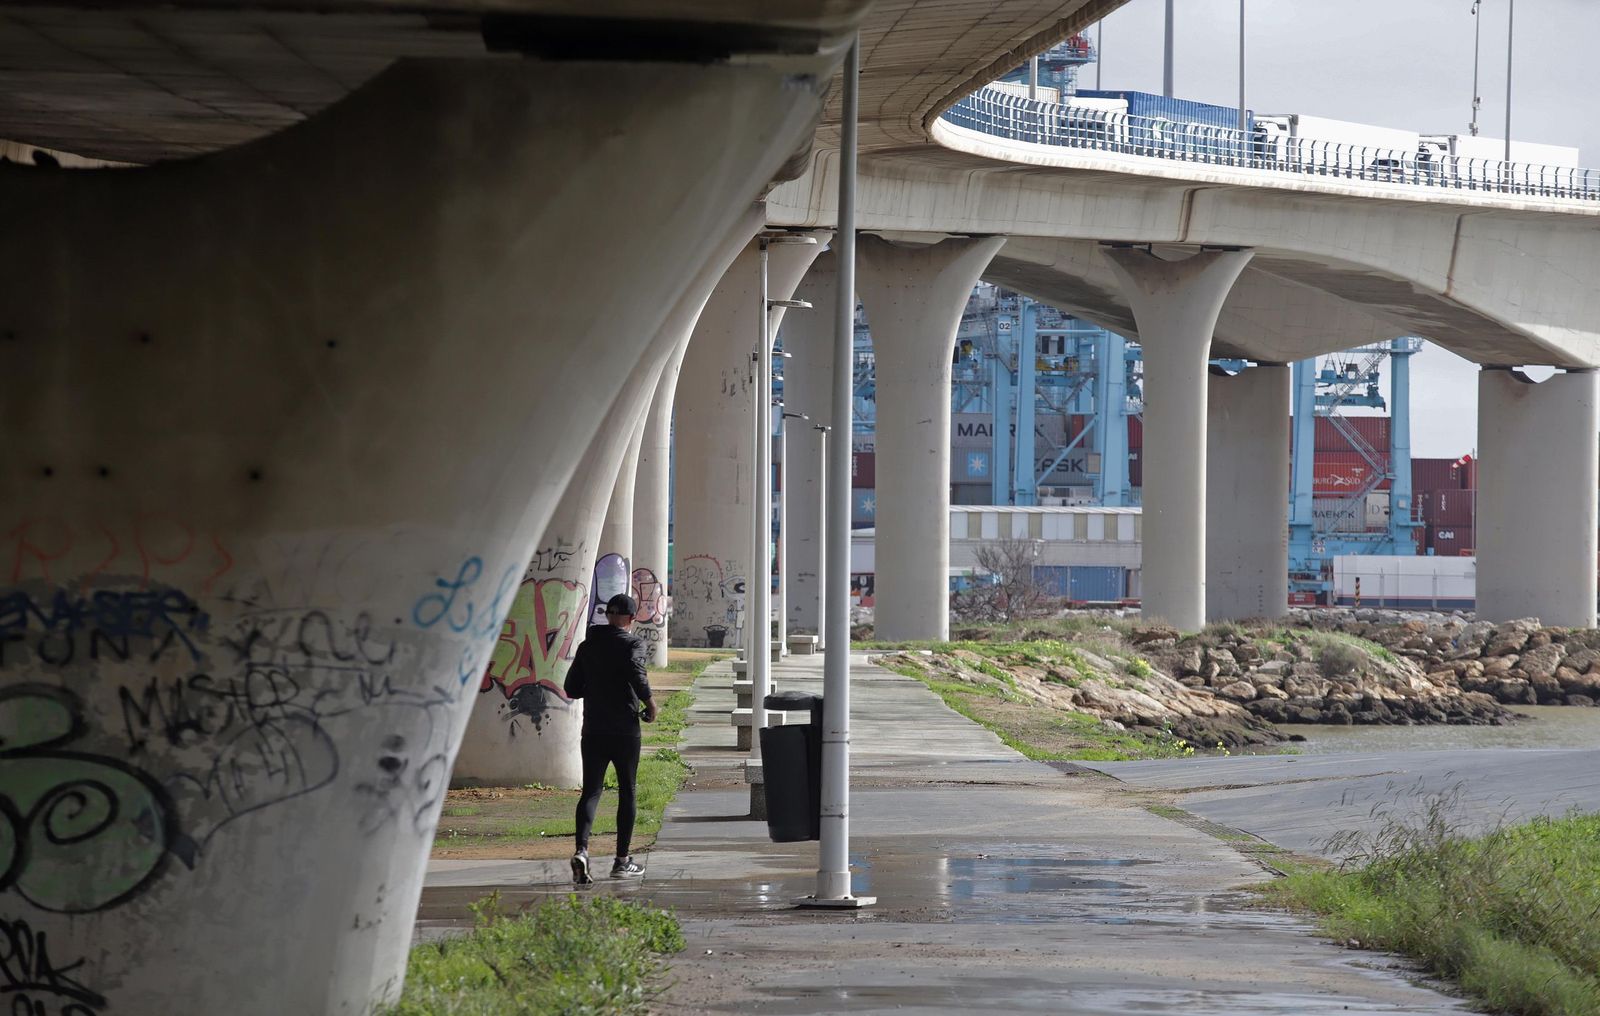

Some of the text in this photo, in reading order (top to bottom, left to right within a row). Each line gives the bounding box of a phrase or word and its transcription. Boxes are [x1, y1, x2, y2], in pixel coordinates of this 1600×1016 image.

[999, 322, 1010, 330] 02
[957, 423, 1044, 437] MARK
[1438, 530, 1454, 539] CAI
